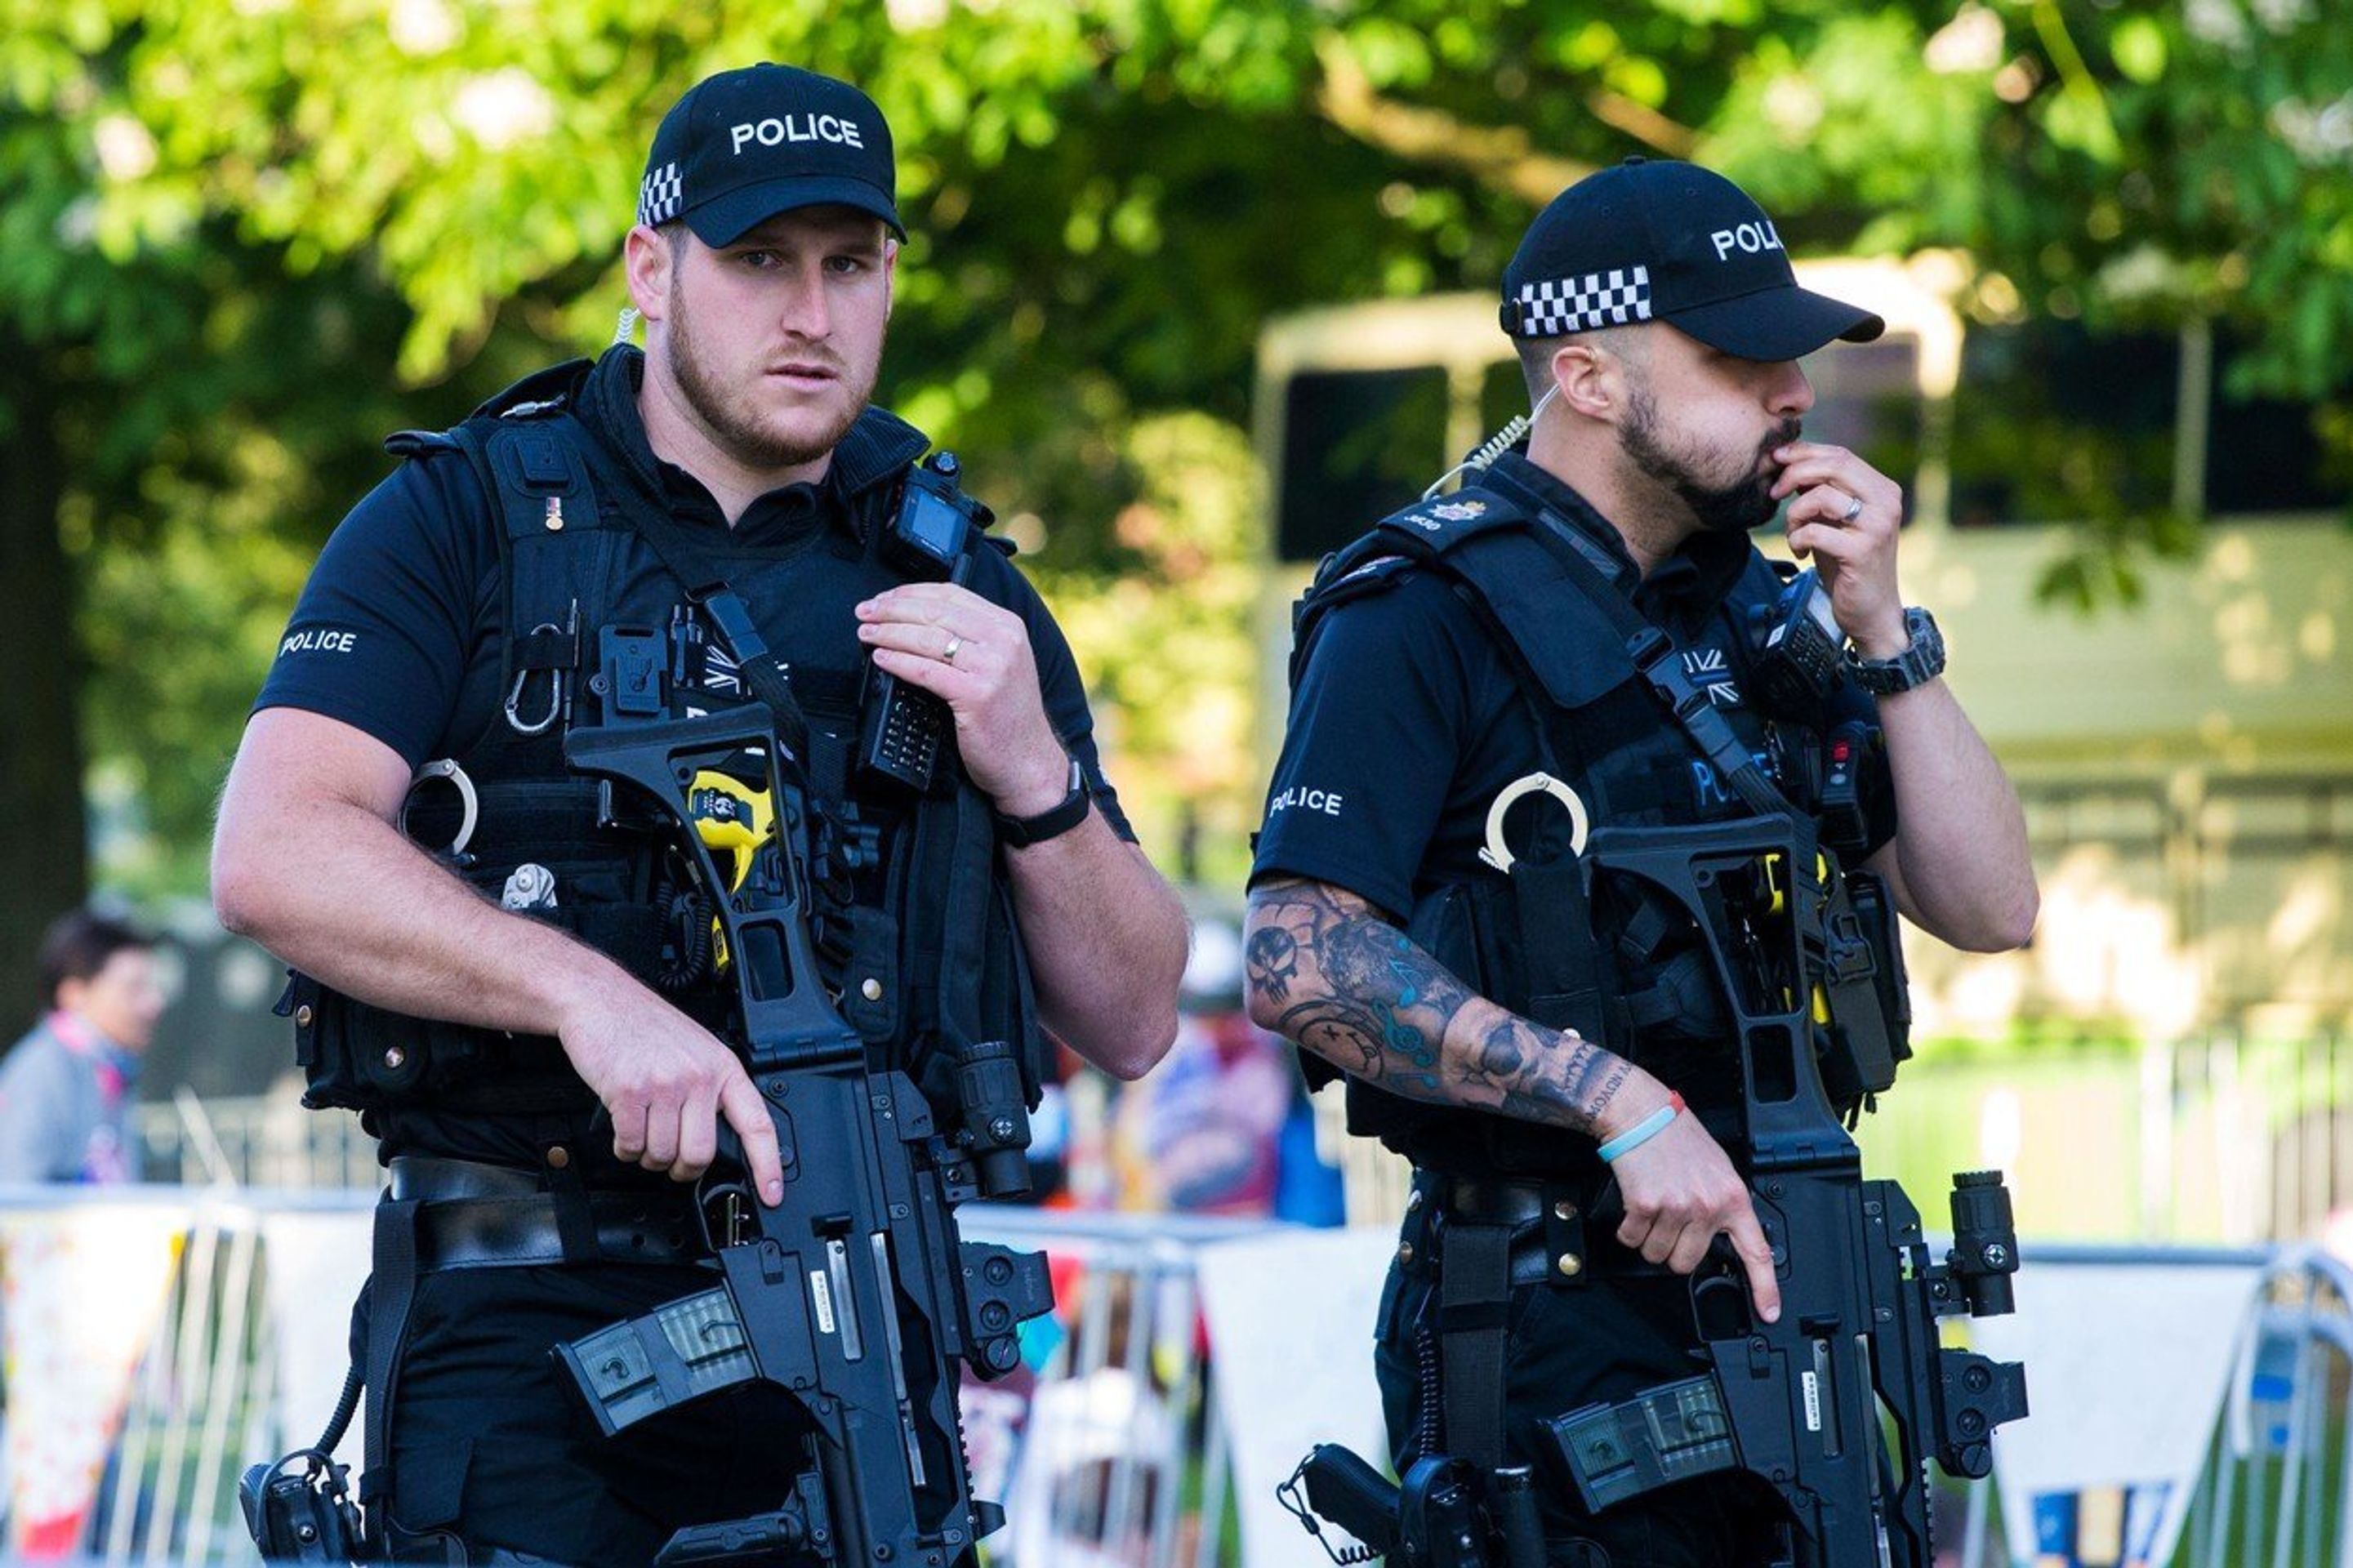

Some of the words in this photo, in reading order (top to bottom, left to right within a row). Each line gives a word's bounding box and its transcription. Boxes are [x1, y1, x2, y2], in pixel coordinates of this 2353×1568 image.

[730, 113, 864, 155] POLICE
[1710, 220, 1785, 261] POLI
[279, 629, 357, 658] POLICE
[1268, 786, 1343, 818] POLICE
